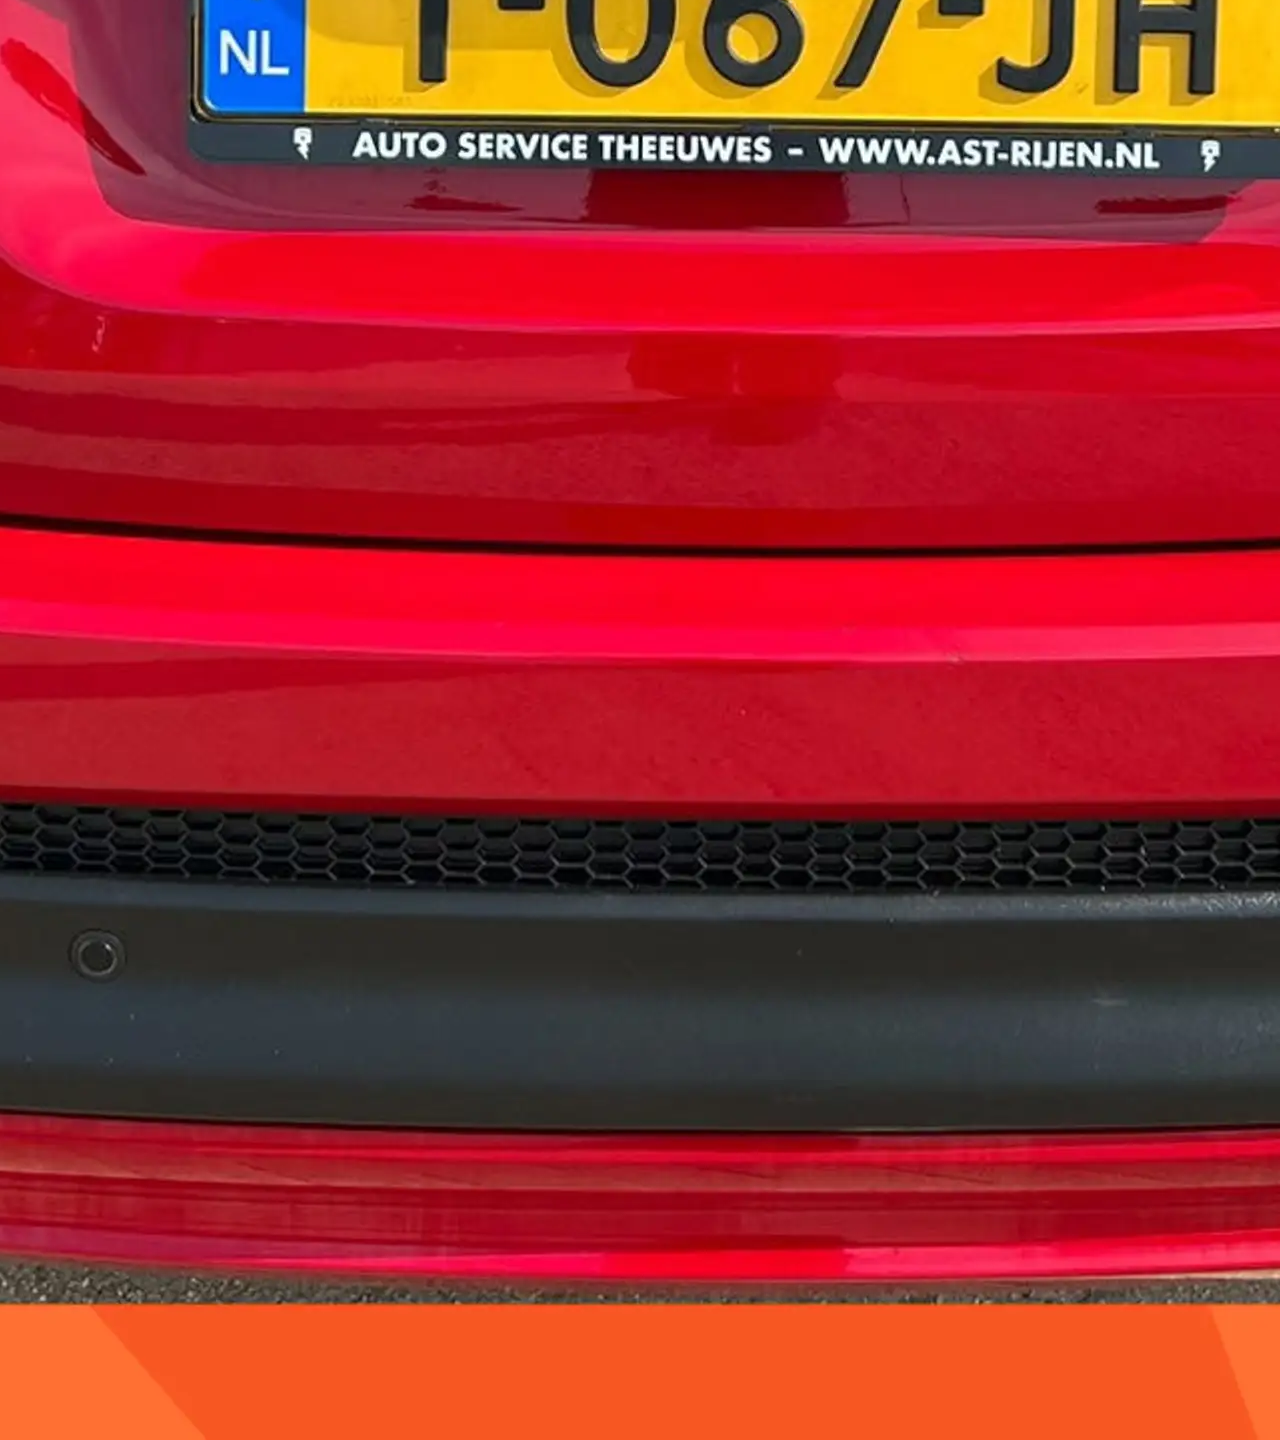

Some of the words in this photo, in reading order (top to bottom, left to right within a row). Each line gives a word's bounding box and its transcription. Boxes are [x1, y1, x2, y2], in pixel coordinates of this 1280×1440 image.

[219, 30, 289, 75] NL
[352, 132, 447, 159] AUTO
[458, 133, 587, 160] SERVICE
[599, 134, 772, 162] THEEUWES
[819, 137, 1160, 170] WWW.AST-RIJEN.NL
